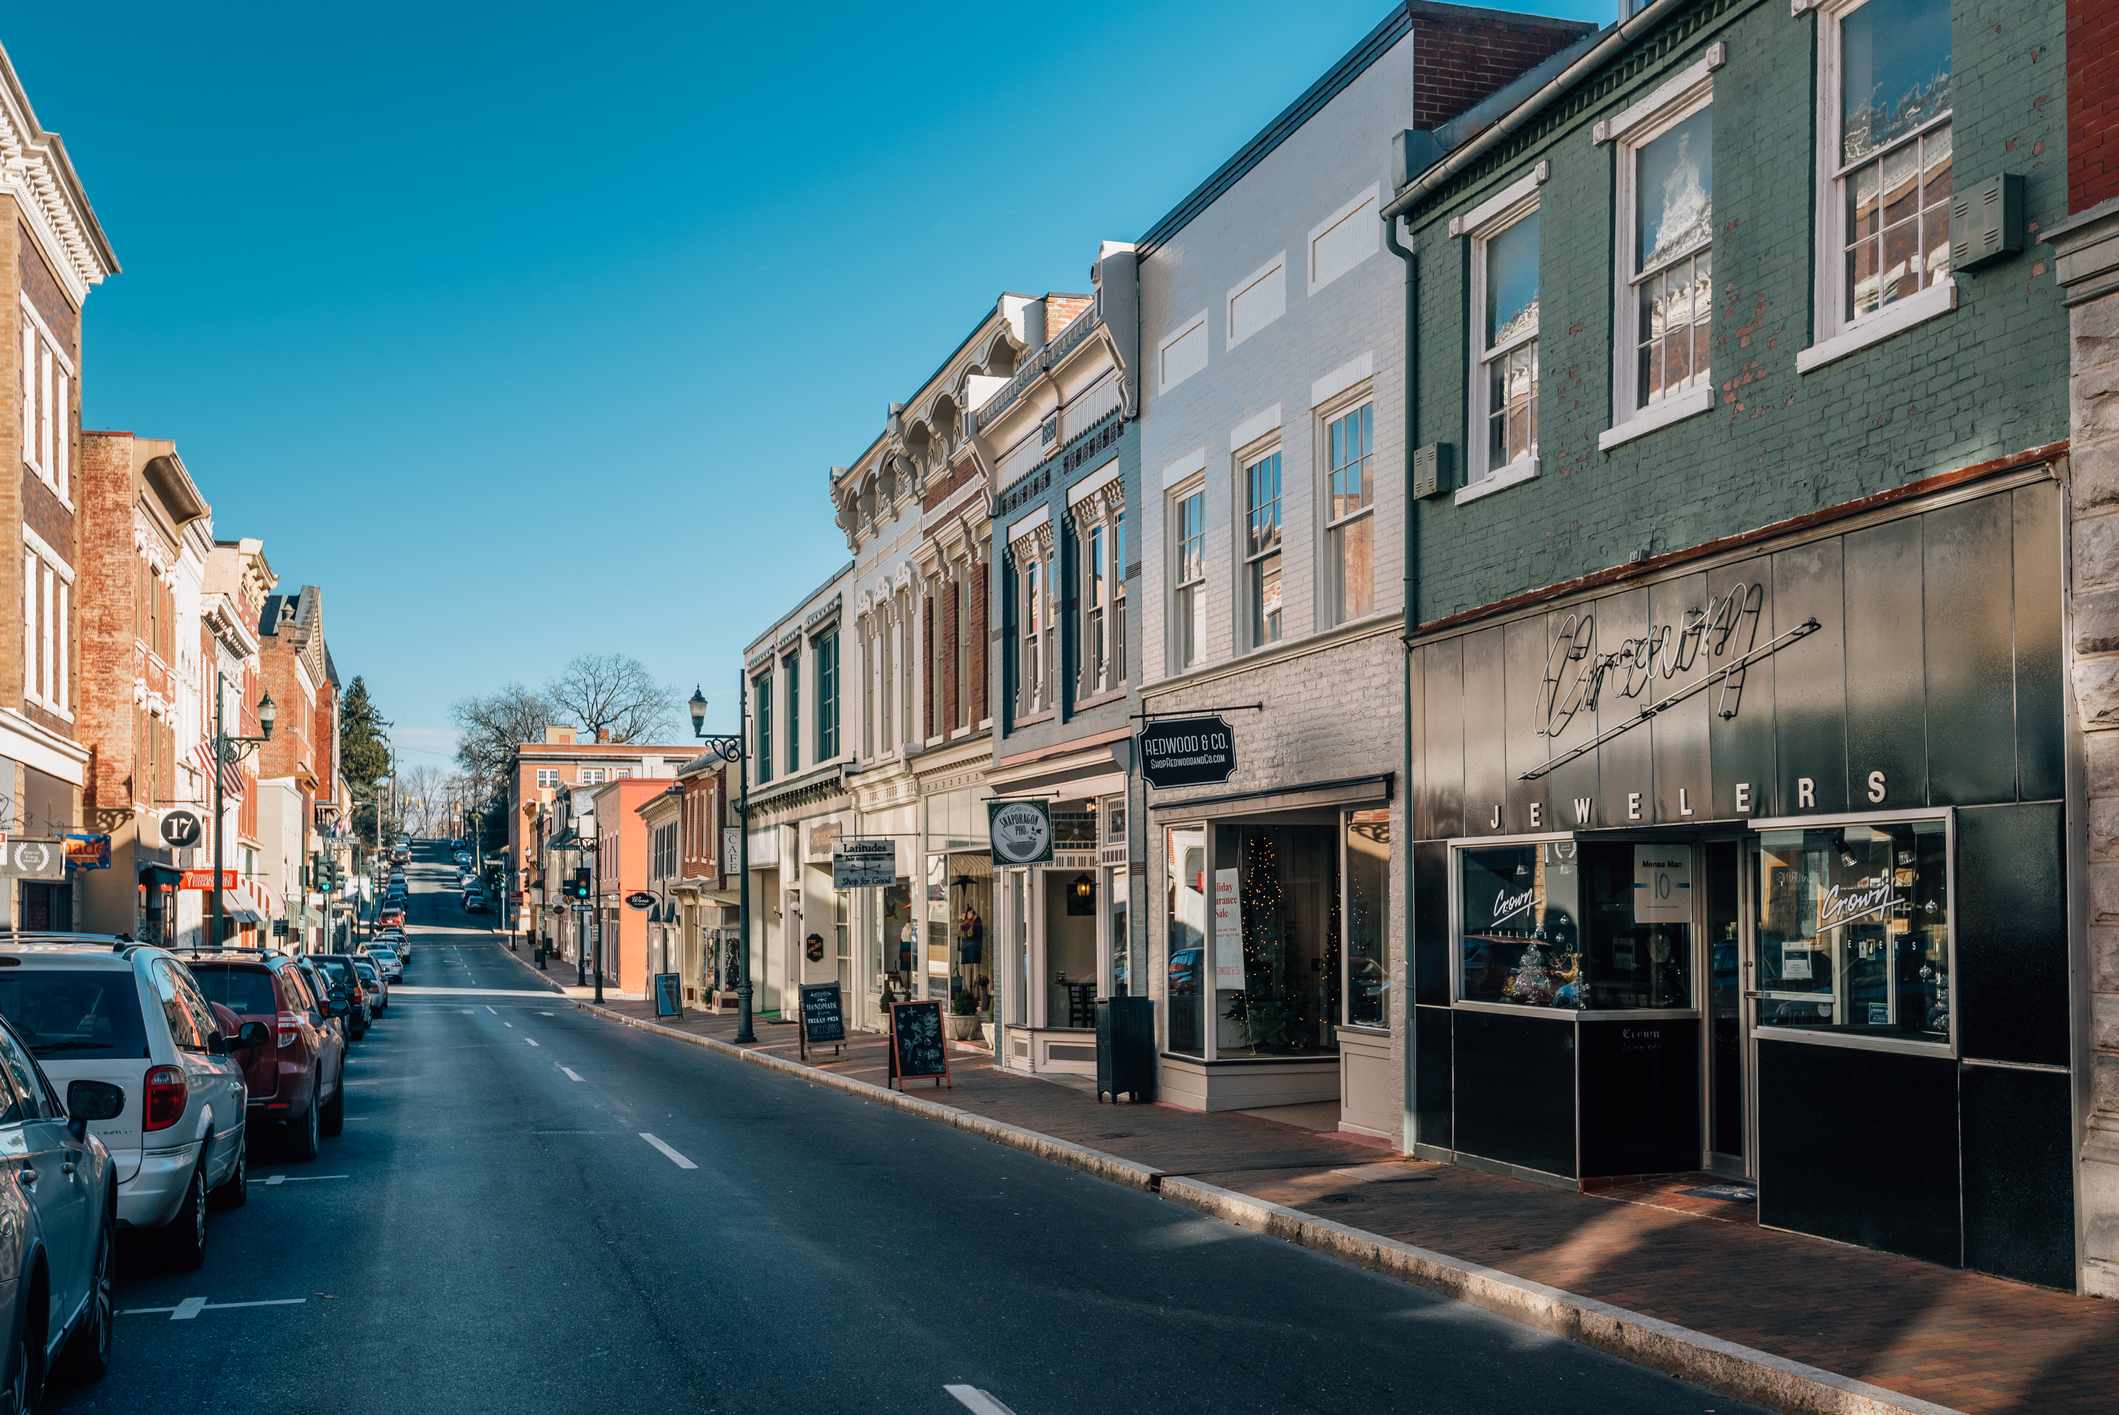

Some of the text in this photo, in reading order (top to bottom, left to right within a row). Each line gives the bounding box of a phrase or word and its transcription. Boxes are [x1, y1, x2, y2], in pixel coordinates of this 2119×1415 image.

[1534, 583, 1752, 737] Crown
[1144, 732, 1229, 756] REDWOOD & CO.
[1490, 770, 1887, 830] JEWELERS
[168, 817, 193, 839] 17
[999, 813, 1040, 828] SNAPDRAGON
[728, 834, 738, 872] CAFE
[843, 843, 887, 853] Latitudes
[1642, 860, 1682, 868] Mensa Man
[841, 876, 891, 886] Shop for Good
[1215, 882, 1233, 893] liday
[1655, 872, 1670, 899] 10
[1215, 896, 1238, 905] arance
[1493, 888, 1533, 917] Crown
[1821, 883, 1891, 921] Crown
[806, 1001, 838, 1010] HANDMADE
[1622, 1027, 1660, 1039] Crown
